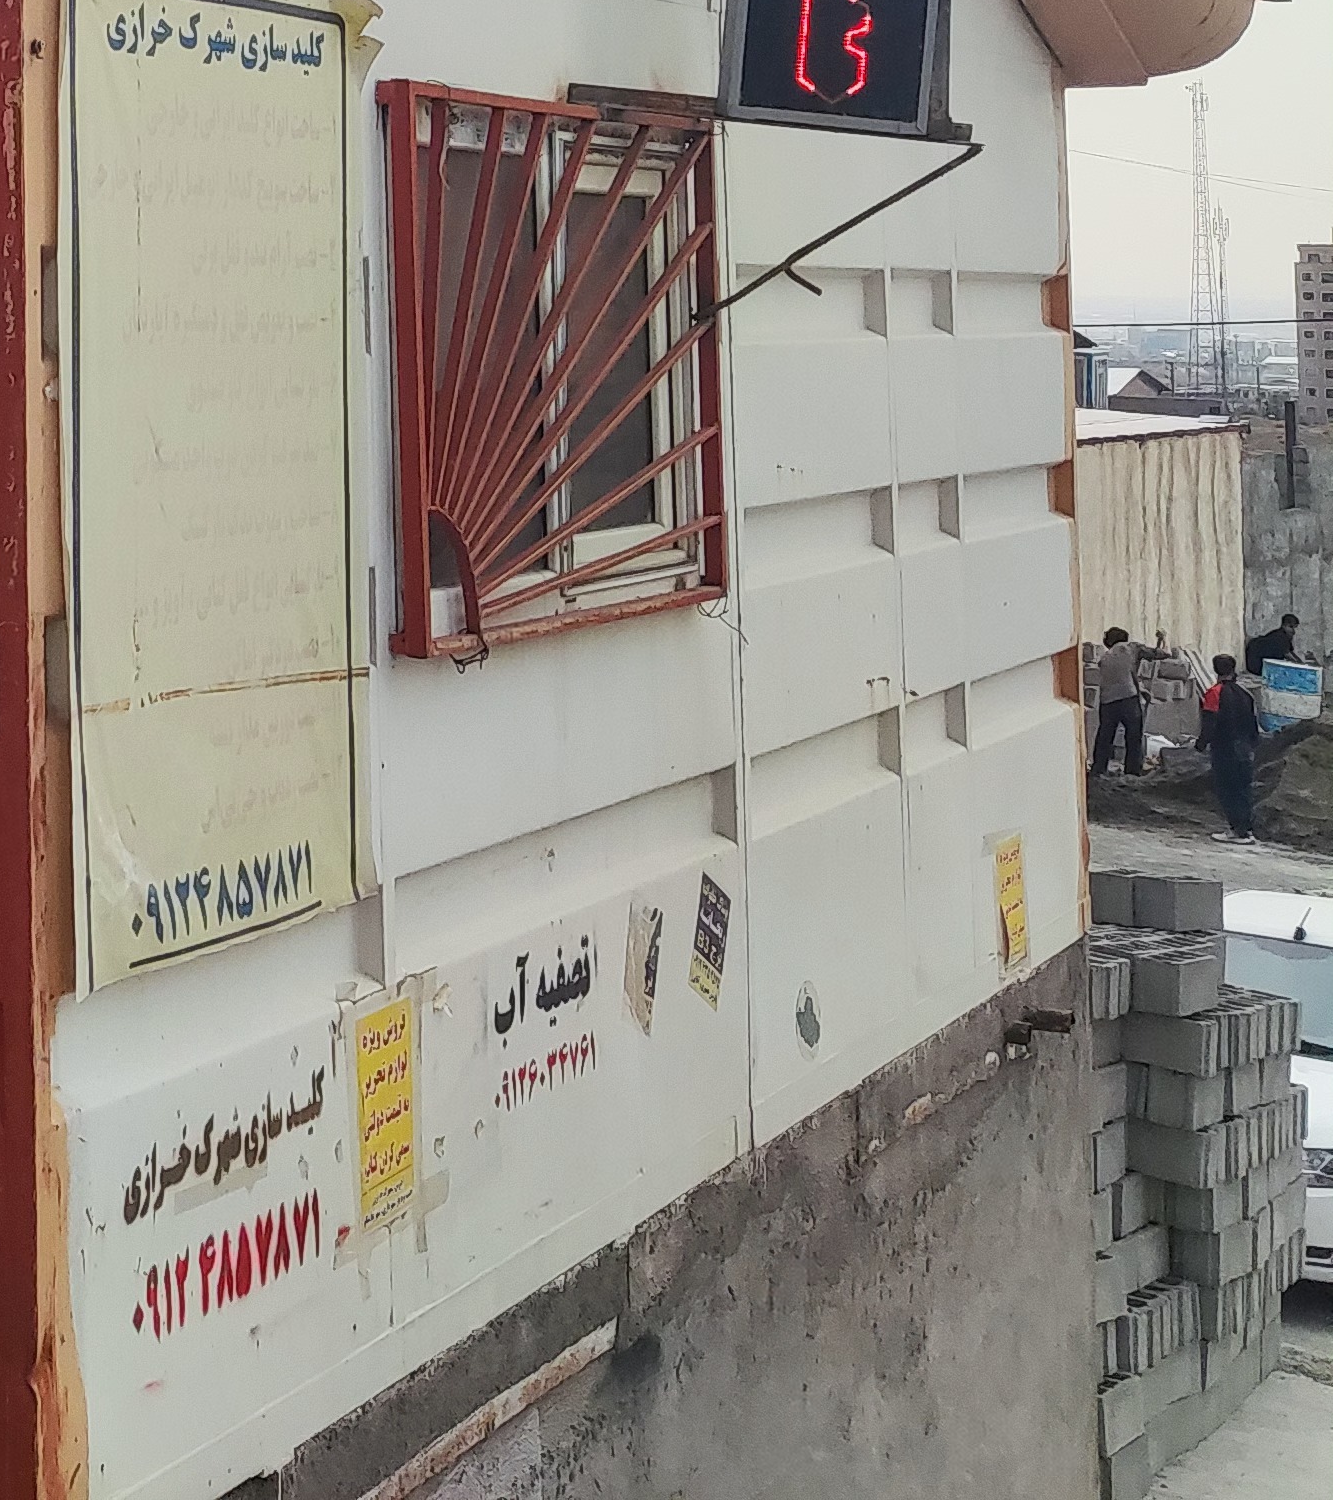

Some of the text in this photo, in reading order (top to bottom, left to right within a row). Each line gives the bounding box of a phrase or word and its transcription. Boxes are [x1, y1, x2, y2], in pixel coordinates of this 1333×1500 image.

[106, 2, 173, 57] خرازی
[240, 24, 287, 73] سازی
[291, 31, 325, 77] کلید
[494, 951, 530, 1050] آب
[536, 934, 591, 1028] تصفیه
[244, 1090, 283, 1169] سازی
[286, 1064, 325, 1136] کلید
[123, 1114, 192, 1226] خرازی
